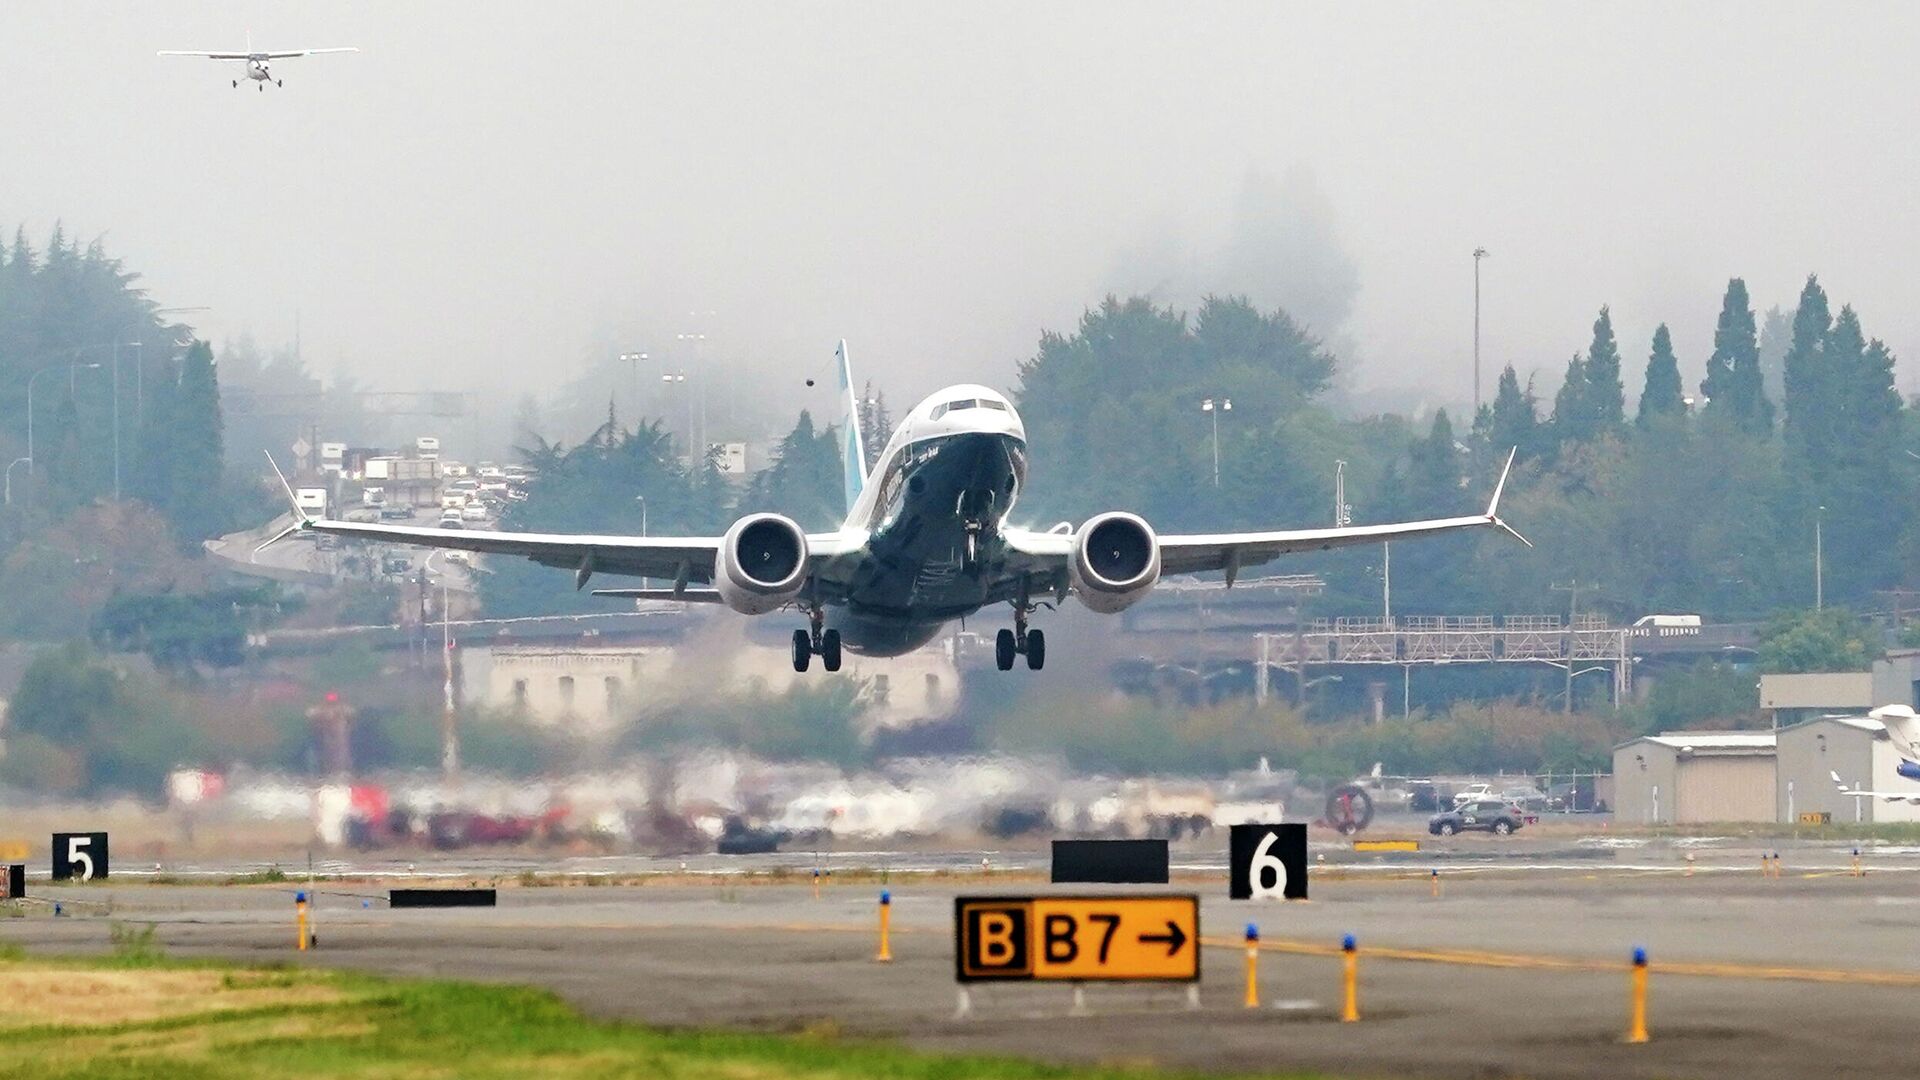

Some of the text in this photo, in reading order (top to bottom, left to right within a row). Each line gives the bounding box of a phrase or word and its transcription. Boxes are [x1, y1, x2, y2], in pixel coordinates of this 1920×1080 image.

[68, 837, 94, 882] 5
[1249, 831, 1288, 898] 6
[979, 912, 1121, 966] B B7
